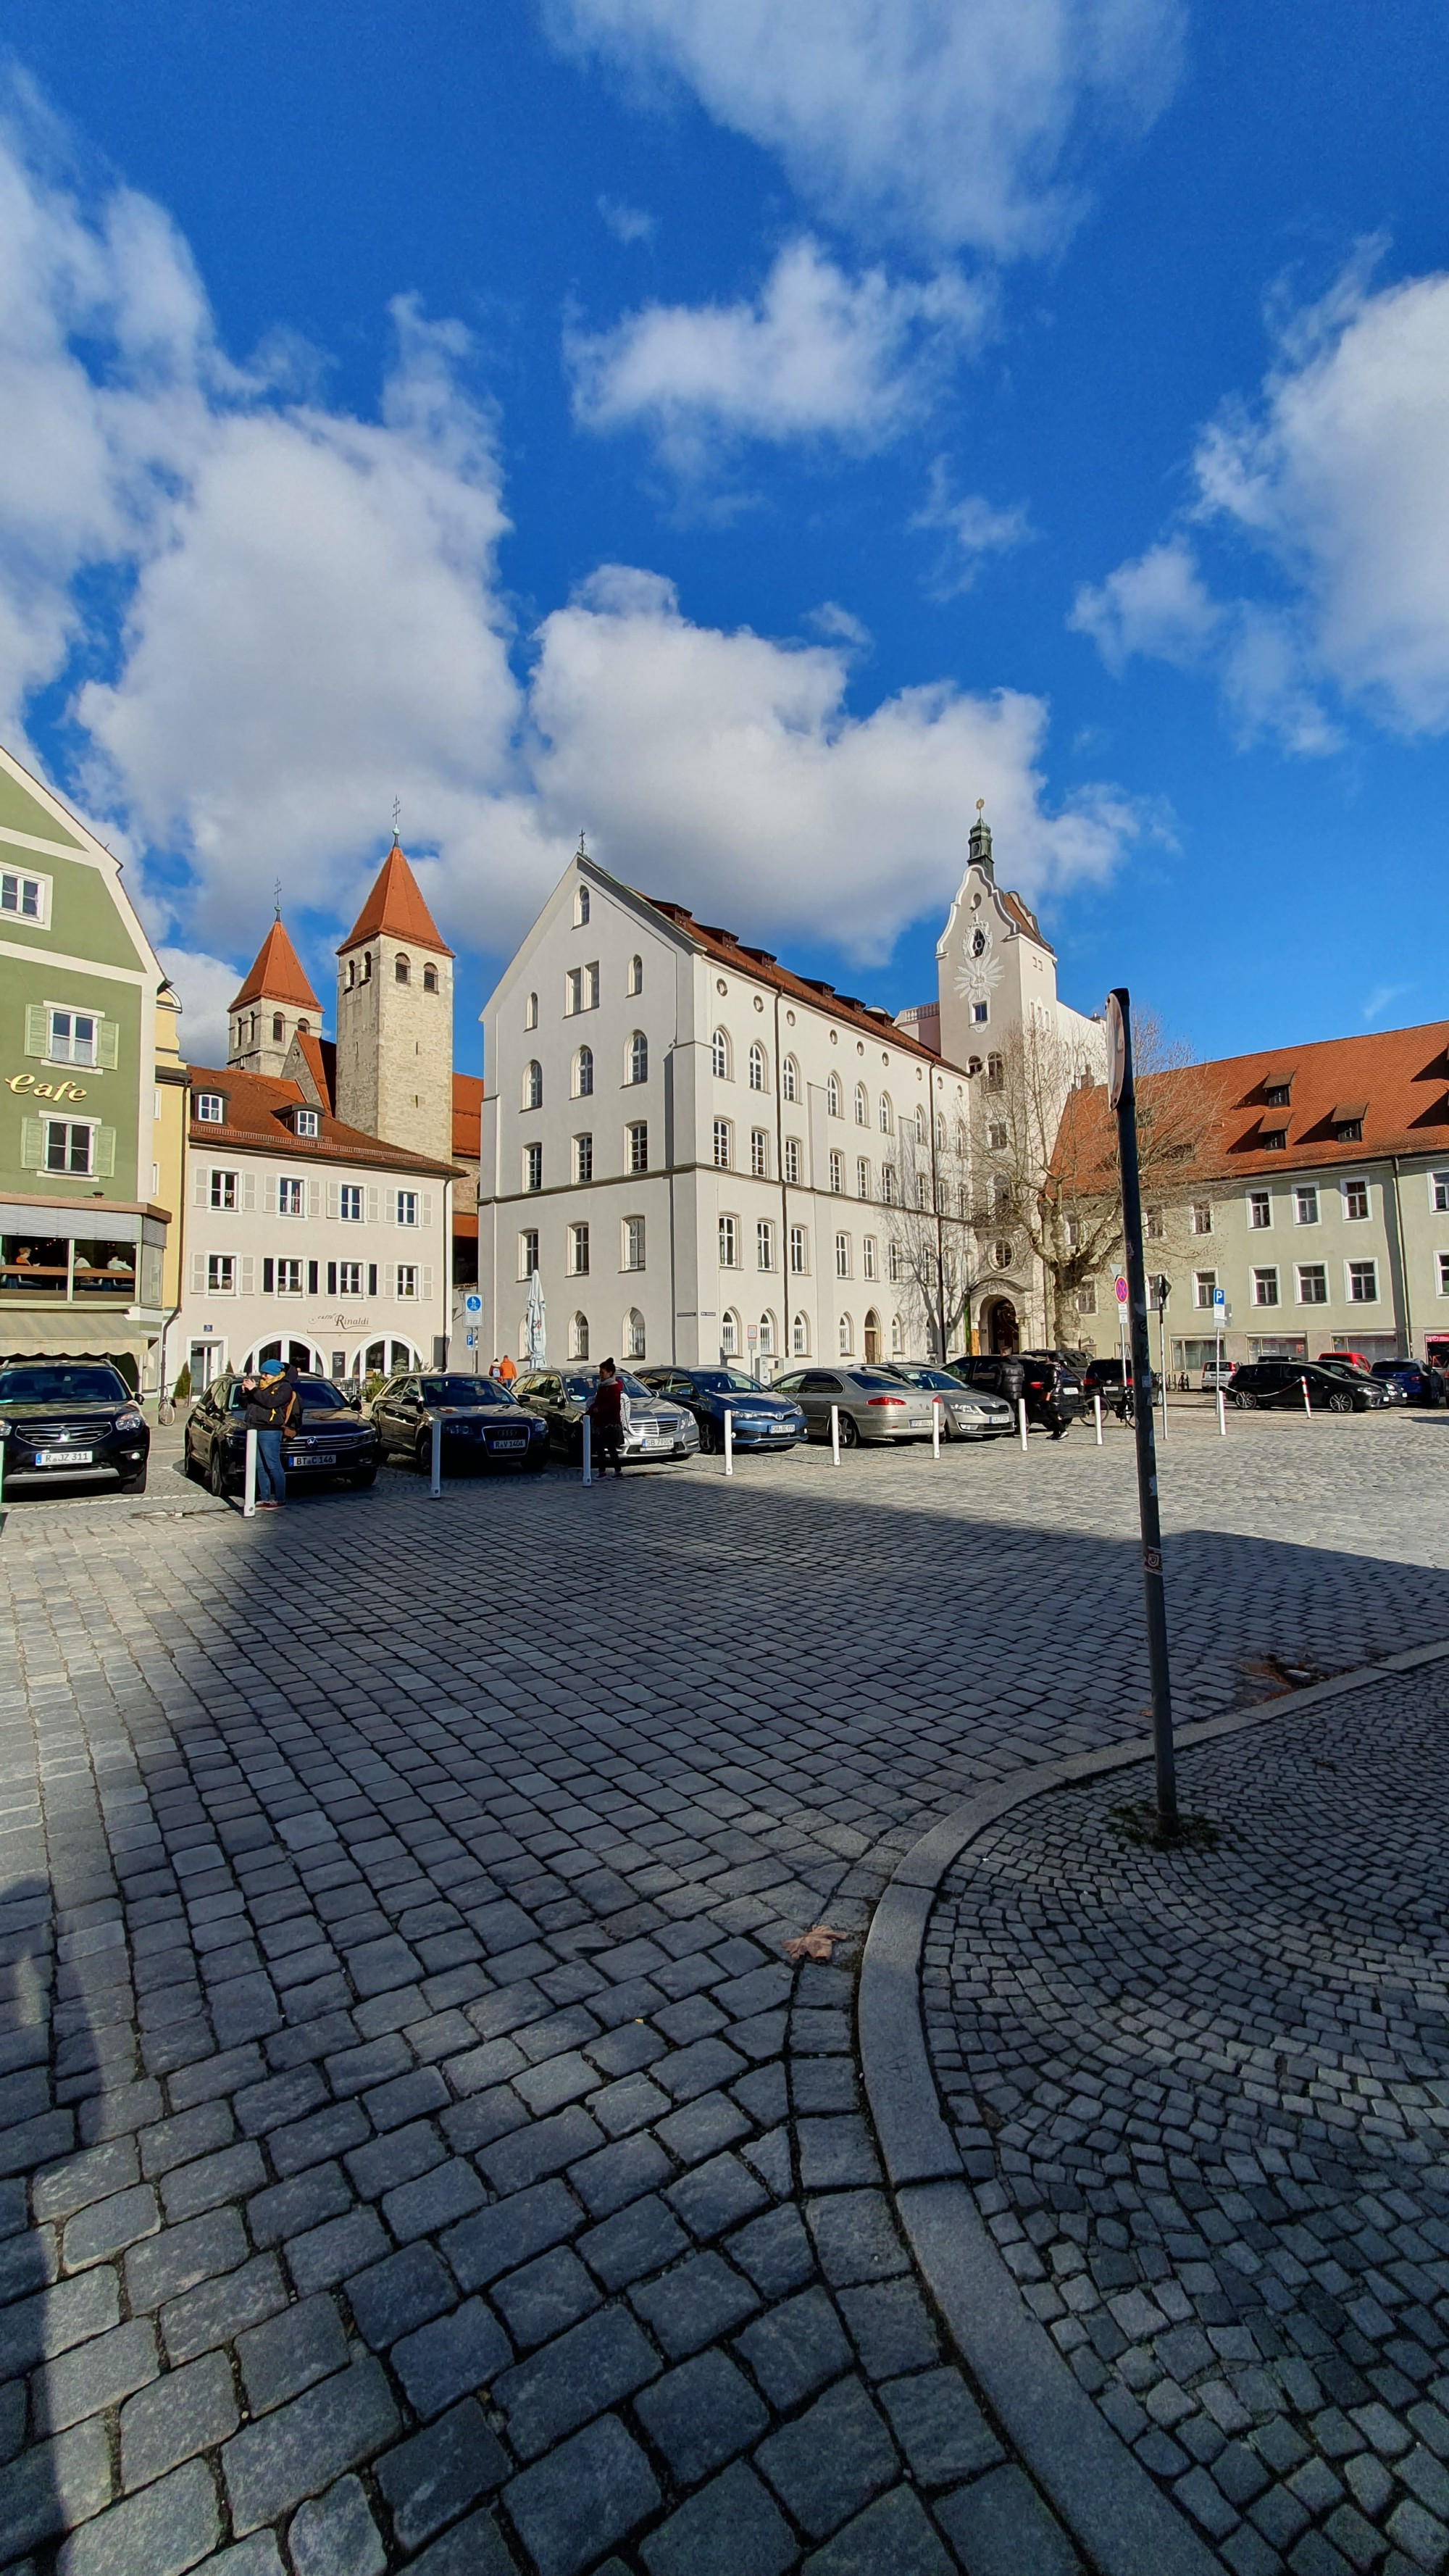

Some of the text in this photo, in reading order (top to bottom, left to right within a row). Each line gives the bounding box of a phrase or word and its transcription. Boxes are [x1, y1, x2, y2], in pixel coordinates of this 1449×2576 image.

[4, 1074, 87, 1102] Cafe
[1216, 1291, 1222, 1302] P
[334, 1313, 372, 1330] Rinaldi
